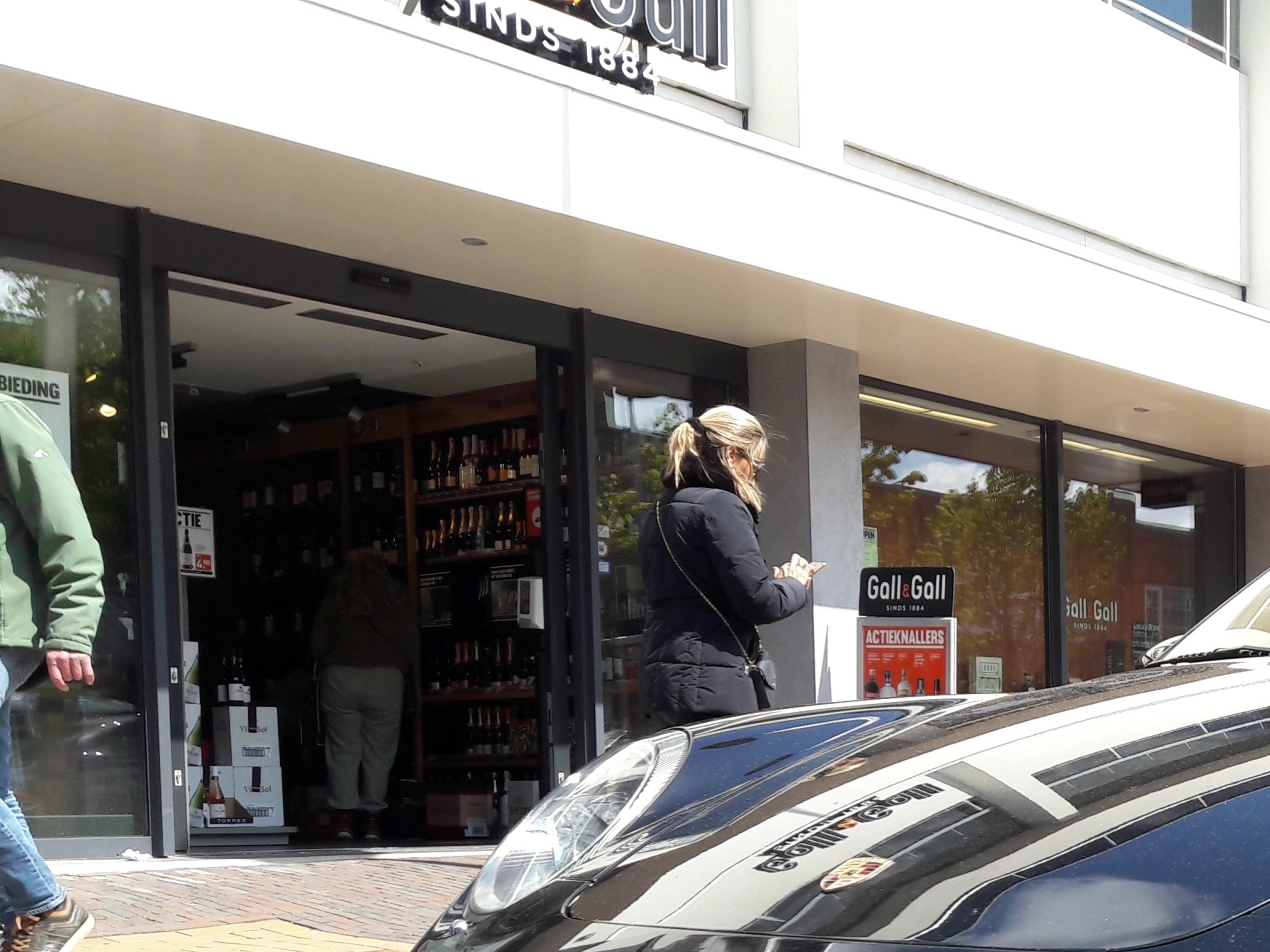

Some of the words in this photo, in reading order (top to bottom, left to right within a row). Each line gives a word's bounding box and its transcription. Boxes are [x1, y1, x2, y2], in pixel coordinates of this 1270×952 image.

[440, 0, 560, 52] SINDS
[583, 43, 661, 87] 1884
[886, 604, 906, 612] SINDS
[909, 604, 924, 612] 1884
[866, 629, 944, 645] ACTIEKNALLERS
